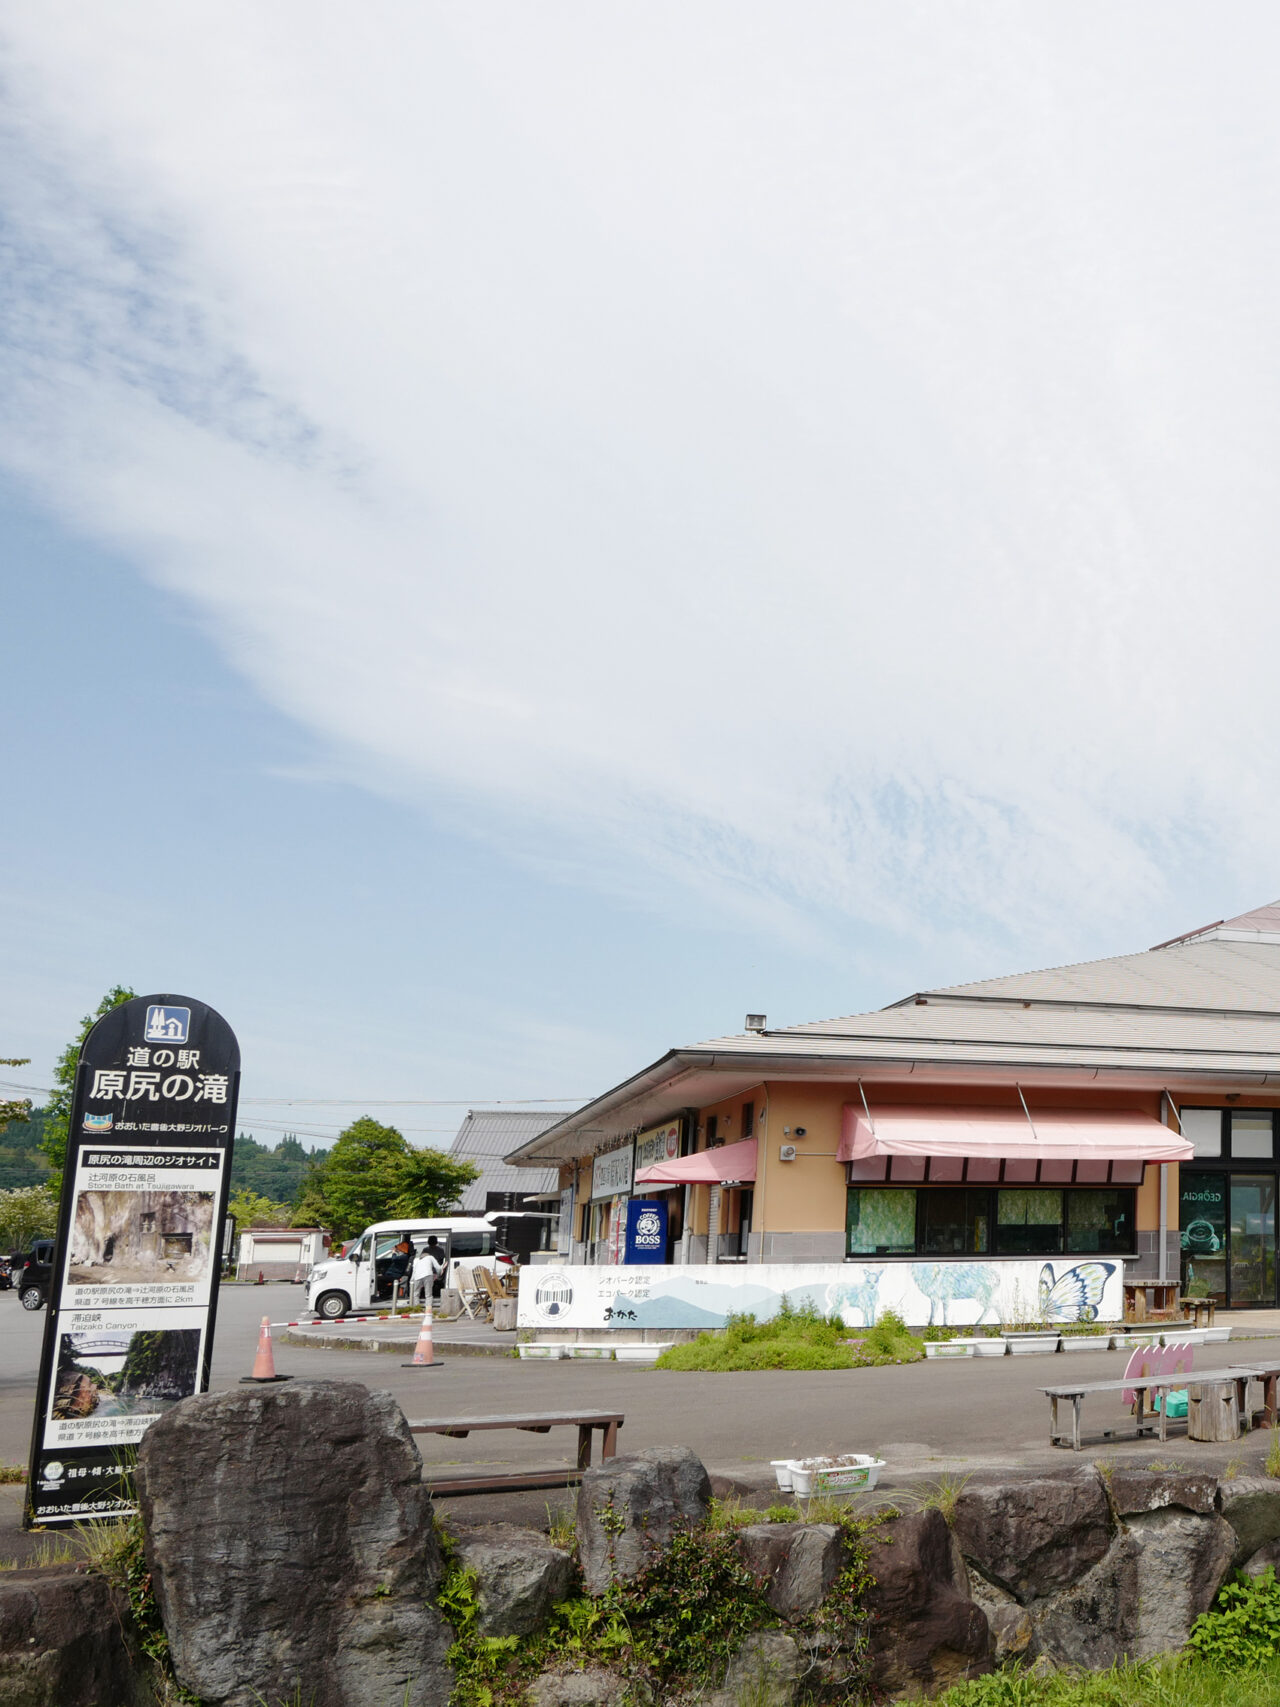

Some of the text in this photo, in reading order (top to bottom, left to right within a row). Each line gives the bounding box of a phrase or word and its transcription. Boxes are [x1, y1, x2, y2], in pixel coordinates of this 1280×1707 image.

[126, 1046, 200, 1070] 道の駅
[89, 1070, 229, 1104] 原尻の滝
[114, 1121, 228, 1133] おおいた豊後大野ジオパーク
[88, 1154, 217, 1167] 原尻の滝周辺のジオサイト
[88, 1173, 156, 1183] 辻河原の石風呂
[114, 1182, 133, 1190] Bath
[147, 1183, 195, 1191] Tsujigawara
[639, 1212, 659, 1220] COFFEE
[635, 1235, 661, 1245] BOSS
[598, 1288, 651, 1298] エコパーク認定
[71, 1322, 138, 1331] Taizako Canyon
